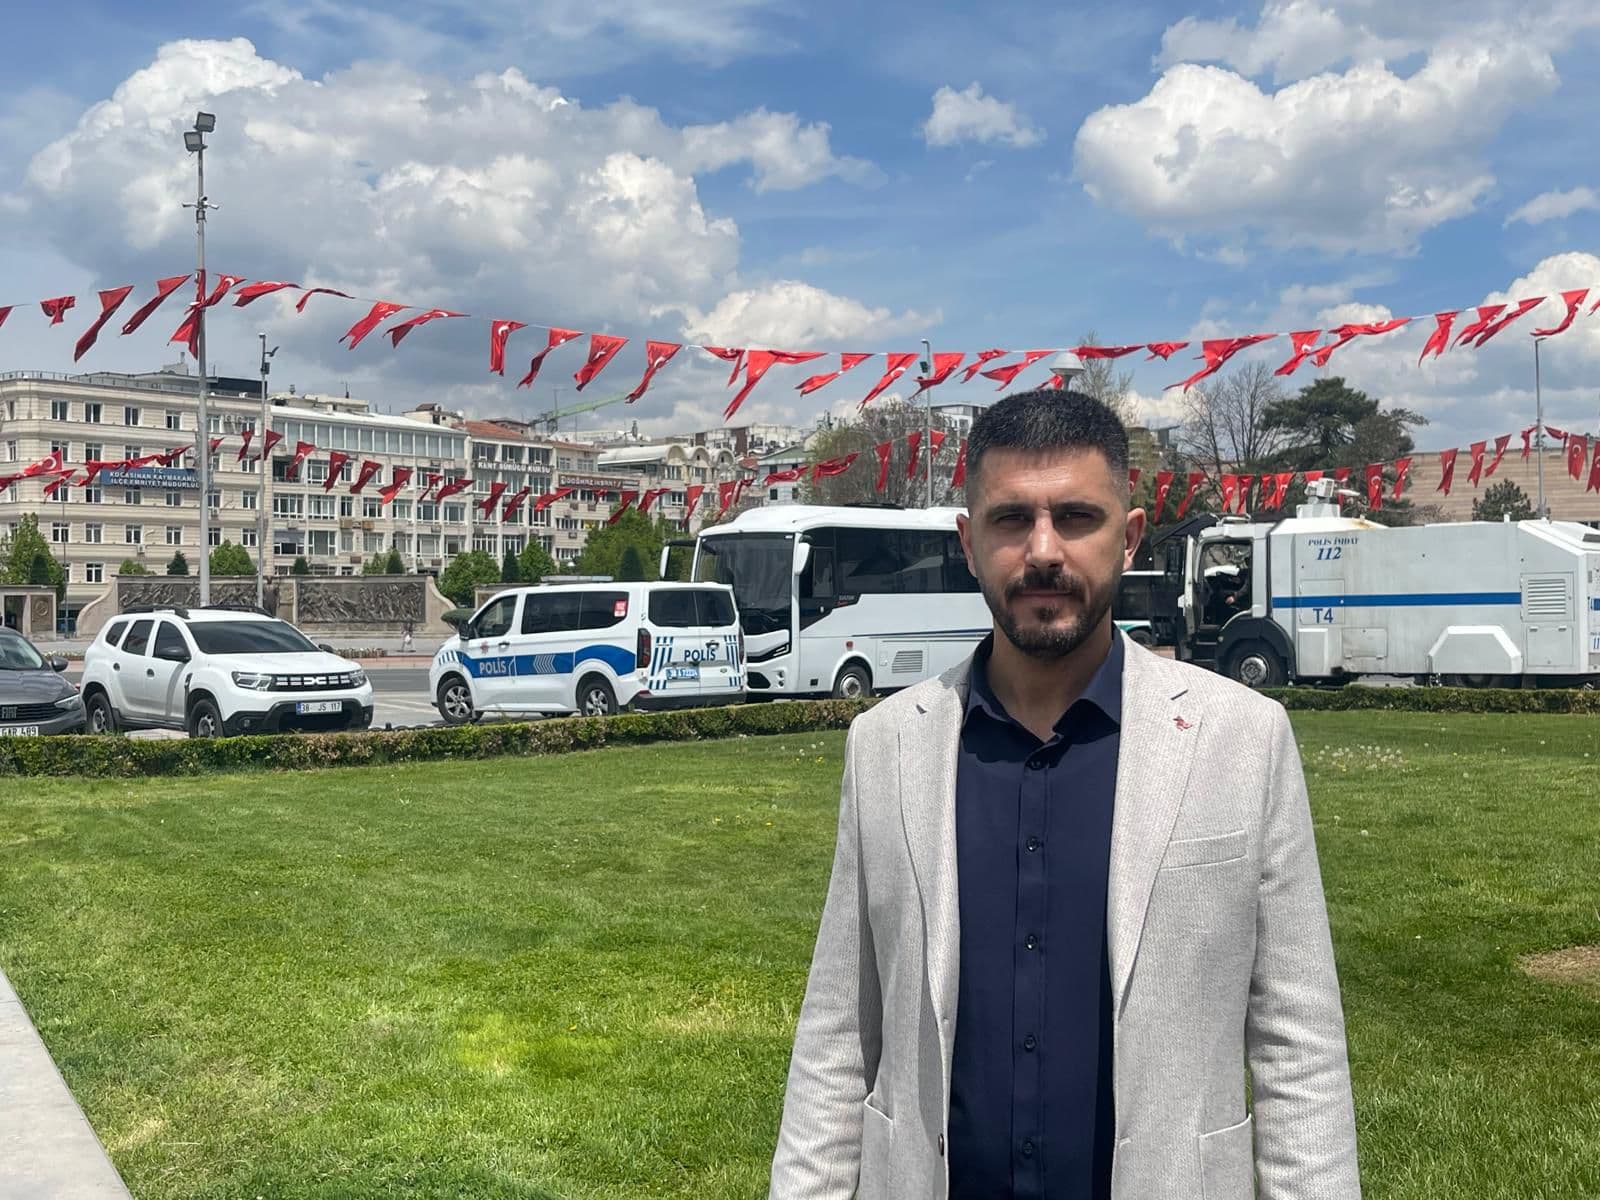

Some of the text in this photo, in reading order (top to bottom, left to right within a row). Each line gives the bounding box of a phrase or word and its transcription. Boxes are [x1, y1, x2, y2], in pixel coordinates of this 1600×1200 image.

[1317, 546, 1342, 560] 112
[1312, 607, 1333, 623] T4
[479, 657, 507, 675] POLİS
